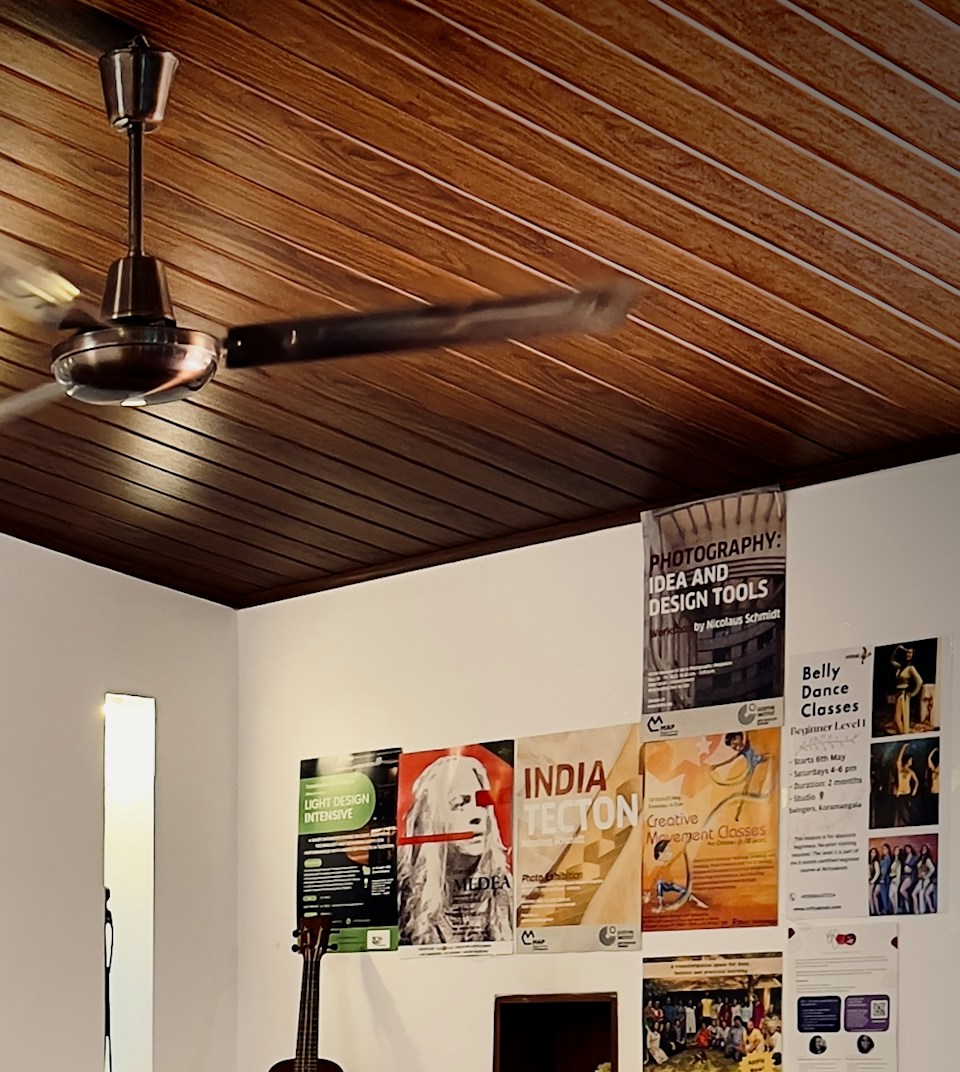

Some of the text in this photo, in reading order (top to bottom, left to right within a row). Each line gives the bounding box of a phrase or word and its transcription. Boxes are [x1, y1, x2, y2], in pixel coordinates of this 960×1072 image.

[650, 531, 781, 573] PHOTOGRAPHY:
[649, 563, 729, 594] IDEA AND
[649, 579, 769, 616] DESIGN TOOLS
[694, 622, 705, 632] by
[706, 616, 743, 630] Nicolaus
[745, 608, 781, 624] Schmidt
[803, 662, 841, 681] Belly
[802, 685, 849, 699] Dance
[801, 702, 859, 718] Classes
[790, 724, 833, 736] Beginner
[834, 718, 860, 731] Level
[524, 760, 607, 799] INDIA
[304, 793, 370, 811] LIGHT DESIGN
[304, 808, 353, 823] INTENSIVE
[523, 793, 639, 836] TECTON
[646, 814, 699, 828] Creative
[646, 825, 766, 844] Movement Classes
[453, 875, 511, 892] MEDEA
